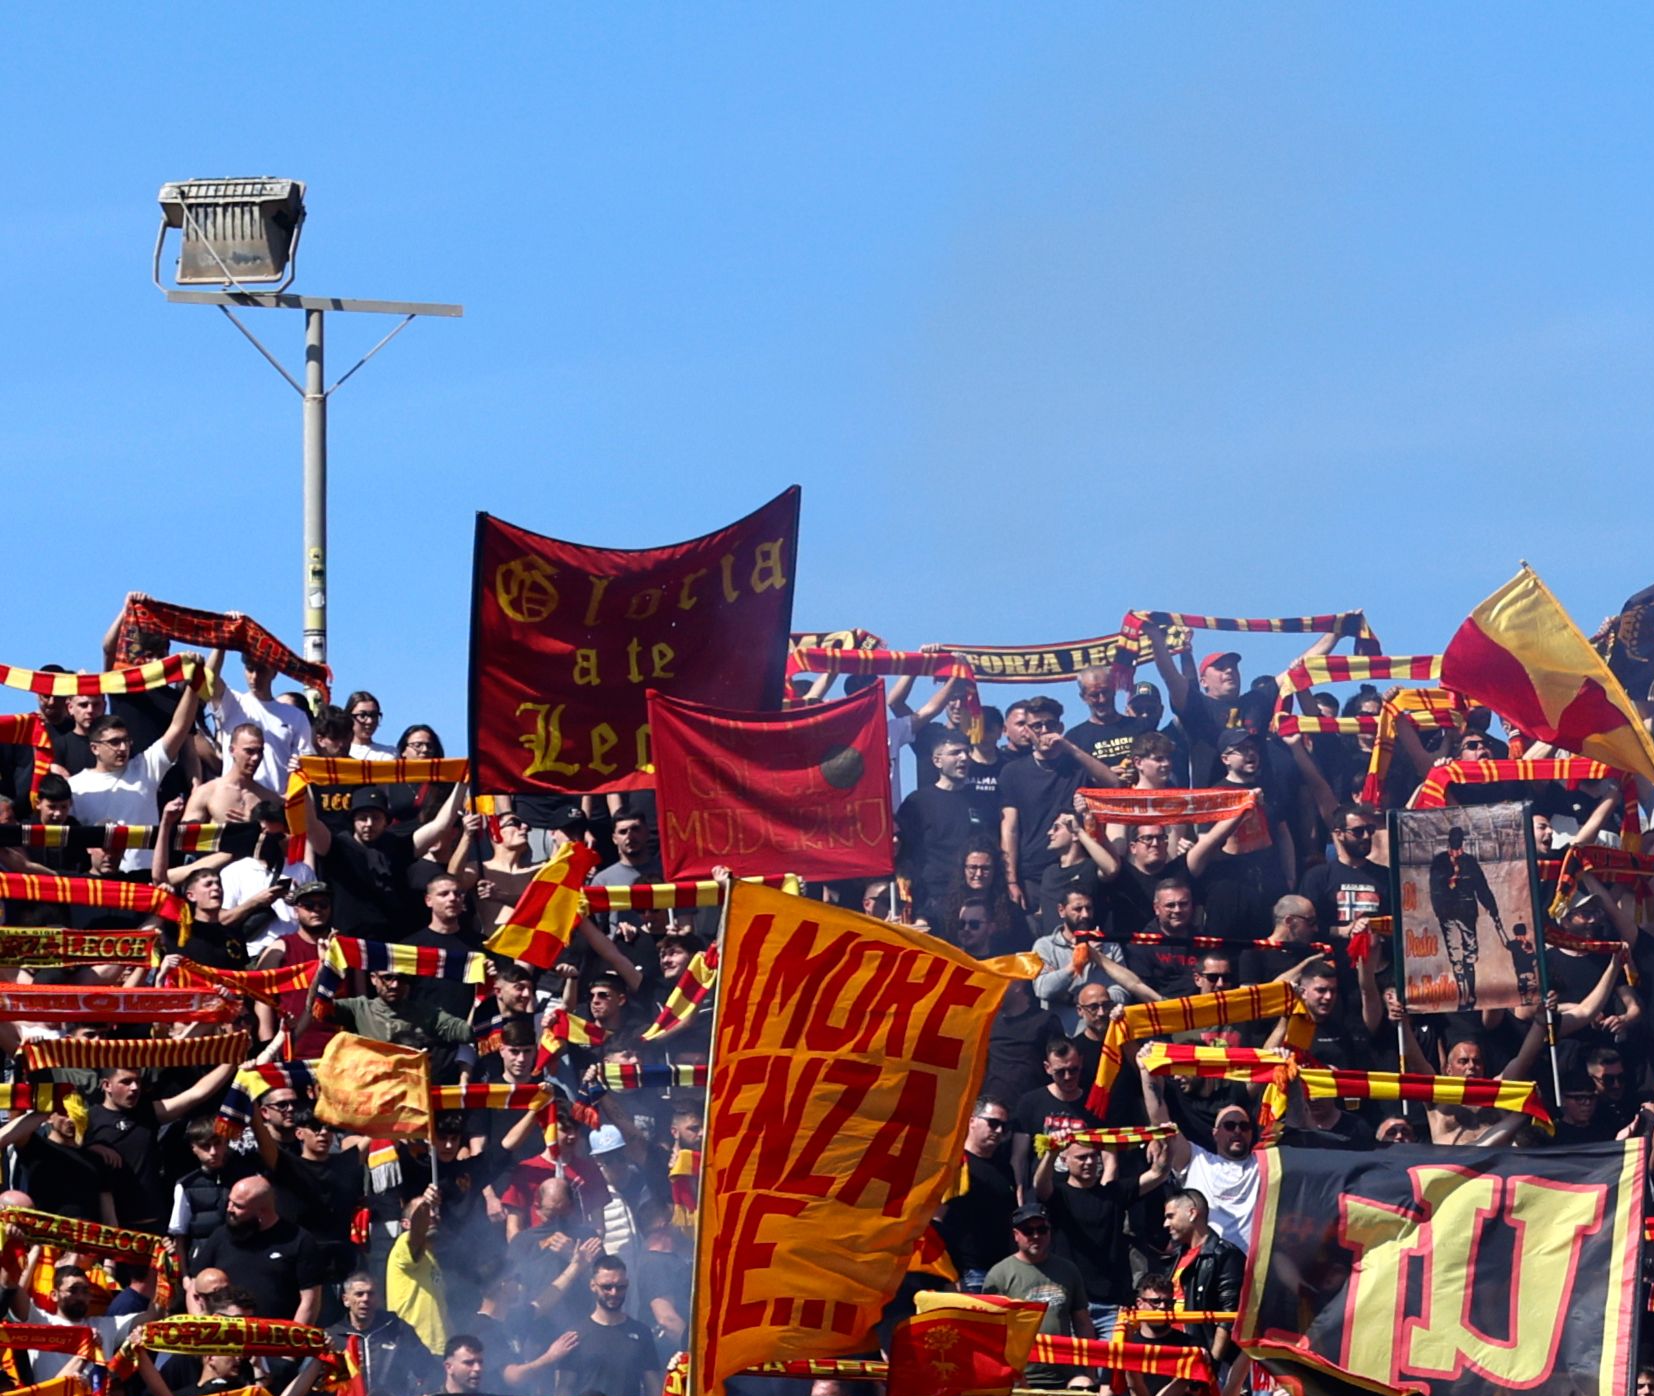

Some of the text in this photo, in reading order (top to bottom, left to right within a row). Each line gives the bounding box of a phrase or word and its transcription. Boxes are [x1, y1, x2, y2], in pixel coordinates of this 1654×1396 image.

[496, 539, 785, 627] Gloria
[574, 637, 675, 687] a te
[968, 650, 1061, 678] FORZA
[65, 934, 147, 959] LECCE
[718, 914, 990, 1070] AMORE
